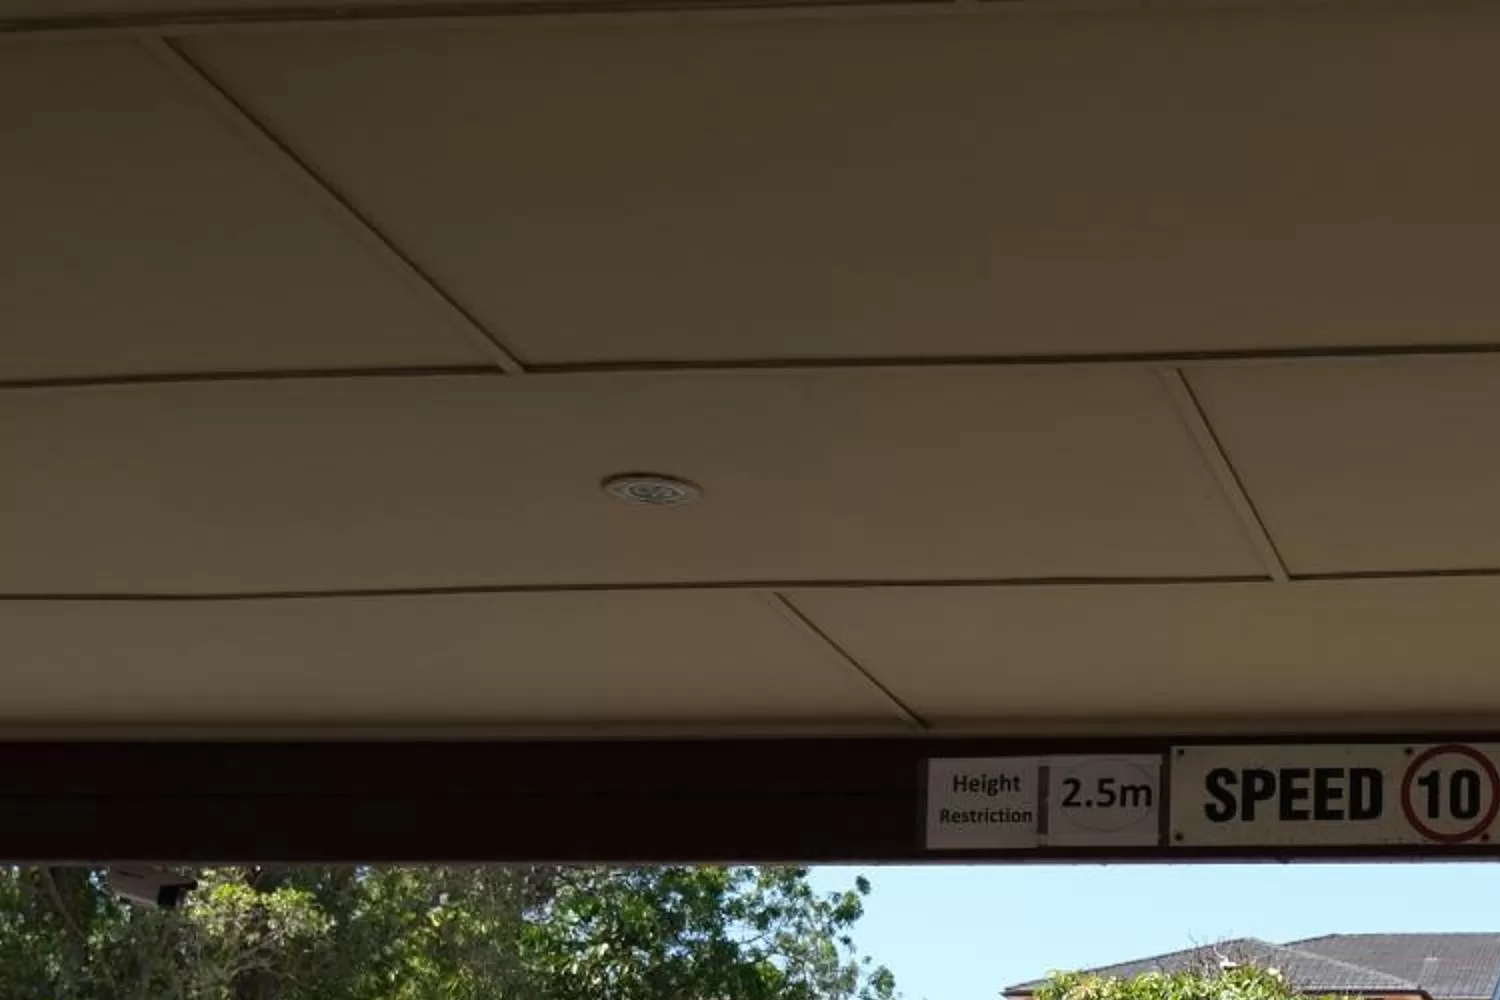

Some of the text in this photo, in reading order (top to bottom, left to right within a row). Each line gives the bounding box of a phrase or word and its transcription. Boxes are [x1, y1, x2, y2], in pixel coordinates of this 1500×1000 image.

[952, 774, 1022, 797] Height
[1062, 778, 1153, 808] 2.5m
[1204, 767, 1383, 823] SPEED
[1417, 769, 1481, 821] 10
[939, 808, 1033, 825] Restriction
